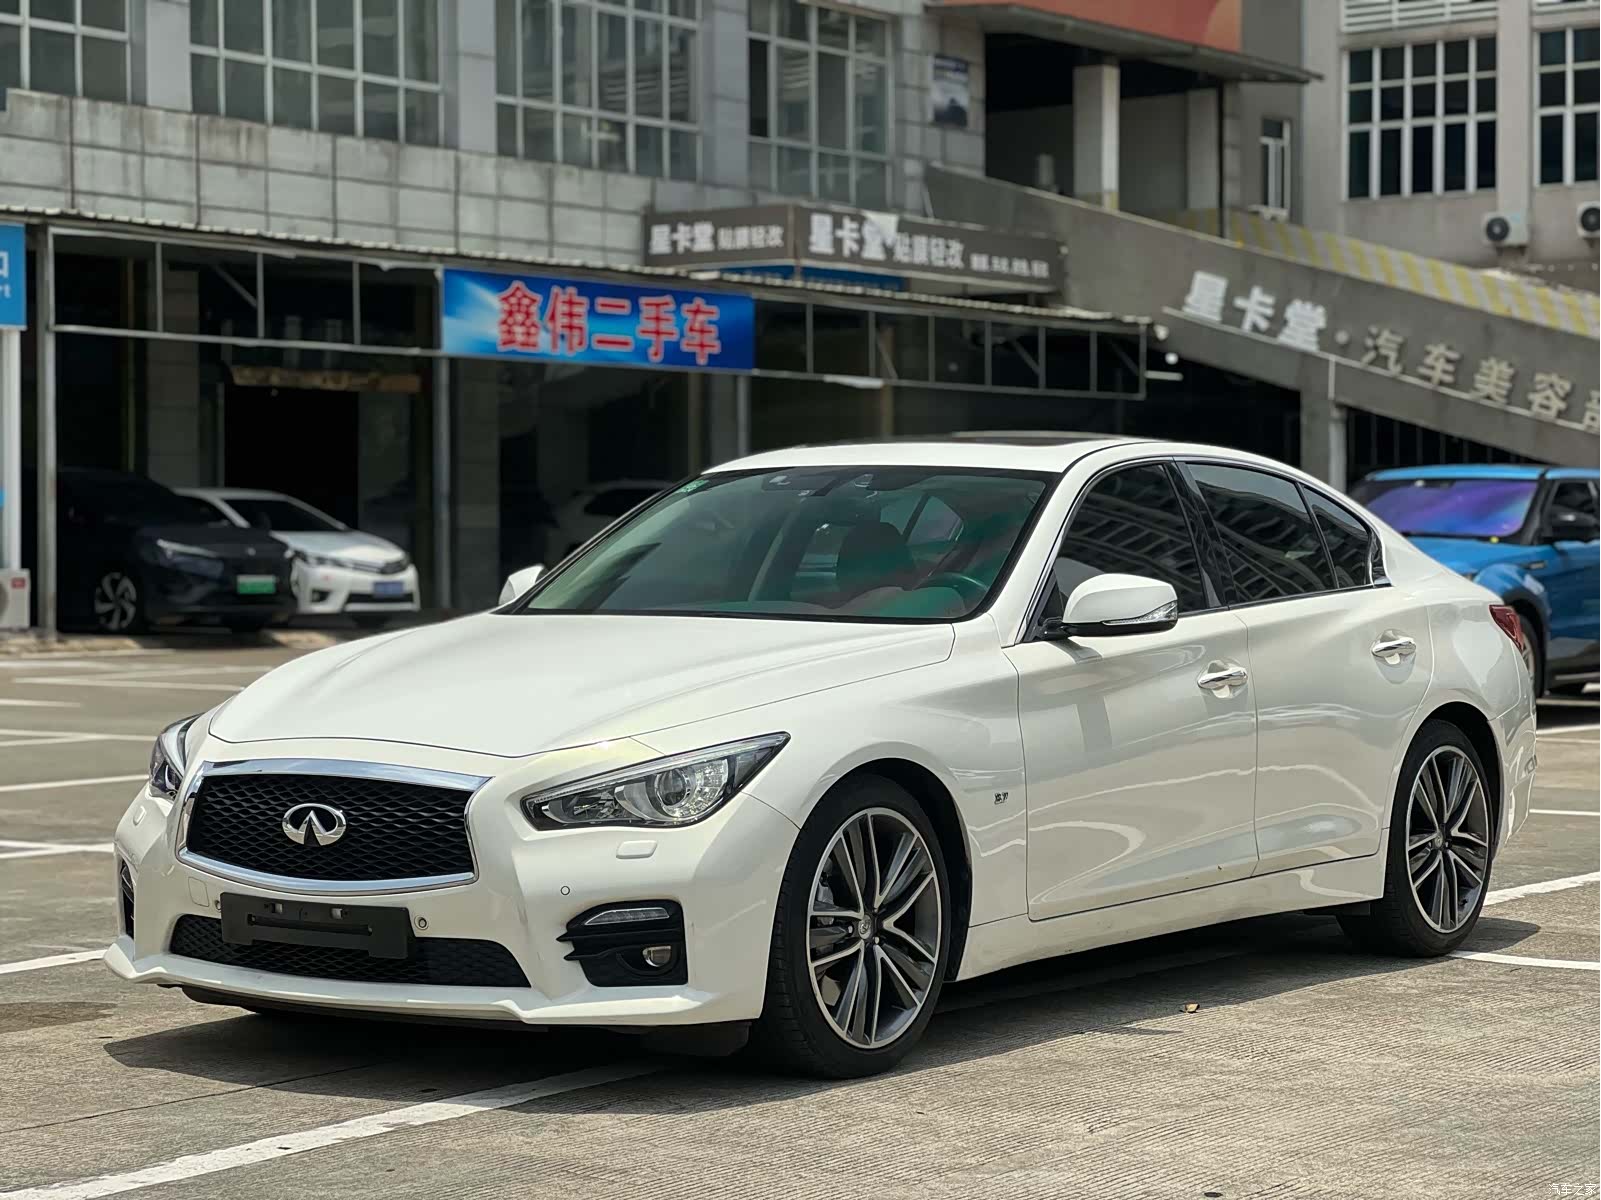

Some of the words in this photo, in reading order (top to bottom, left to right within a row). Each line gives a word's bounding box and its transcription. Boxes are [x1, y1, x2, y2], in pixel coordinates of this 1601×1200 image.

[497, 280, 721, 365] 鑫伟二手车
